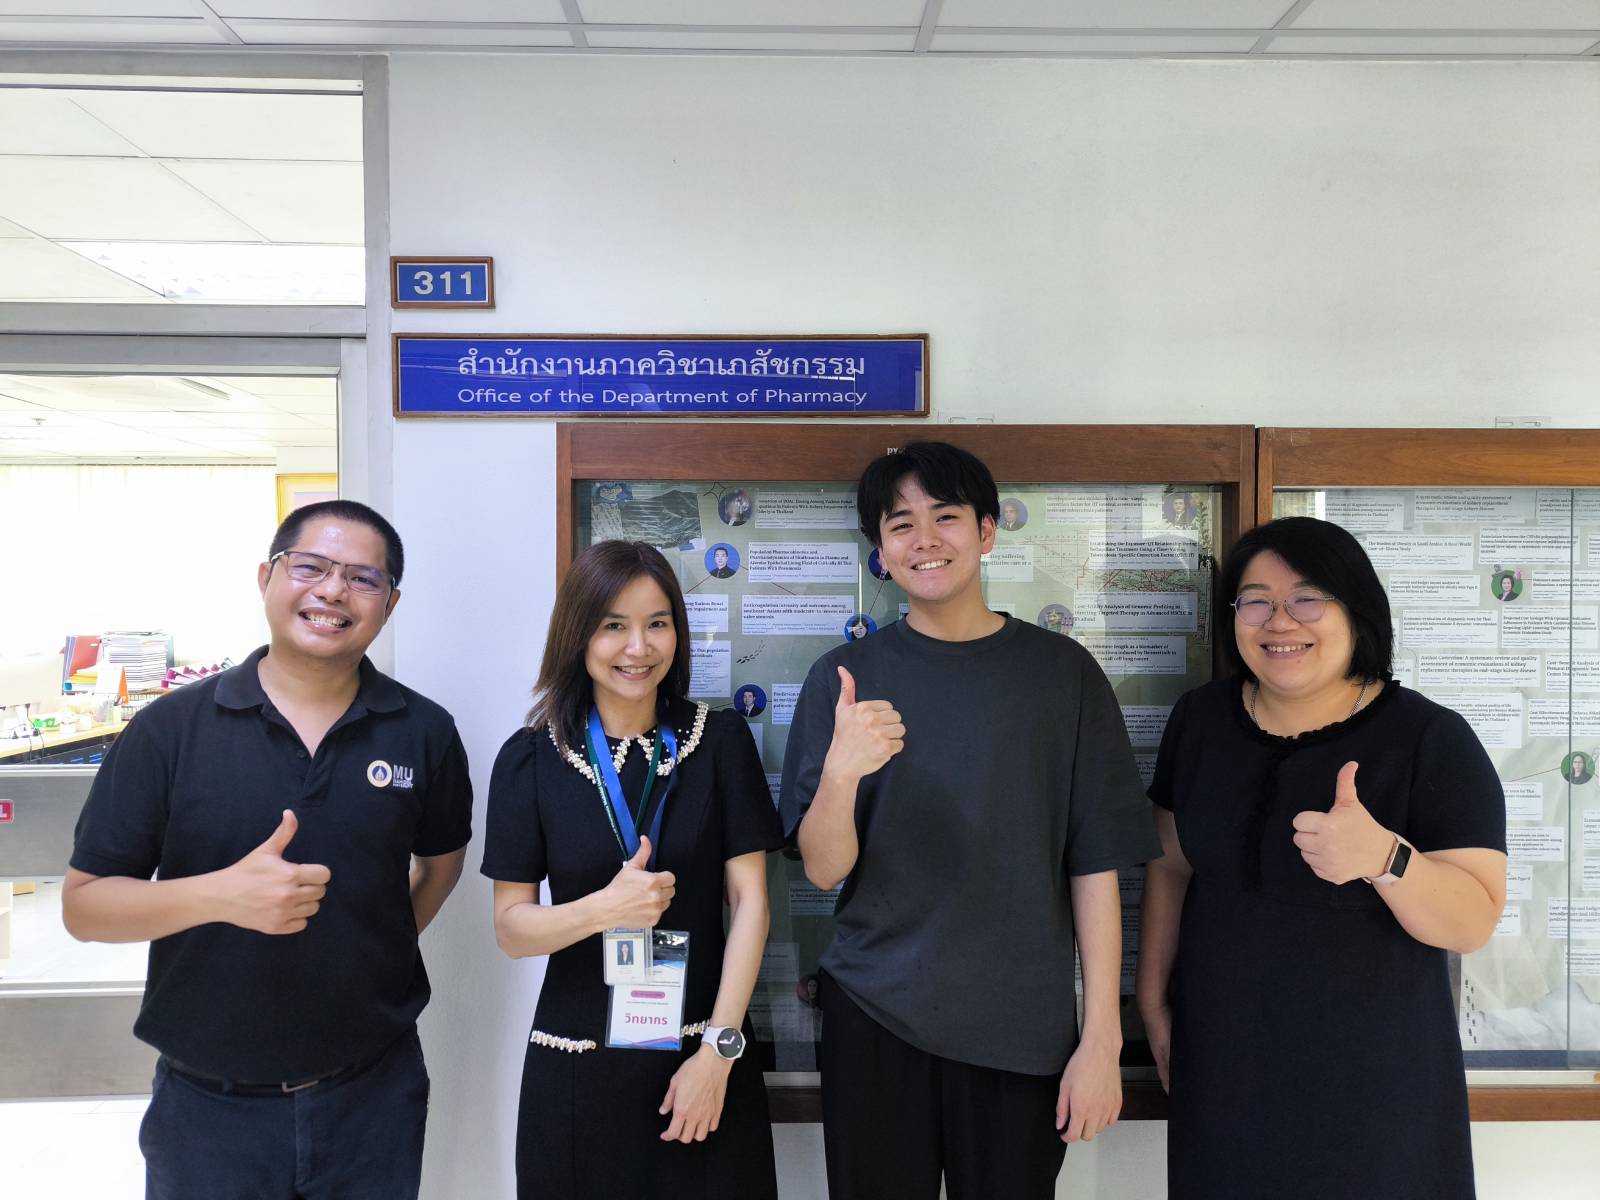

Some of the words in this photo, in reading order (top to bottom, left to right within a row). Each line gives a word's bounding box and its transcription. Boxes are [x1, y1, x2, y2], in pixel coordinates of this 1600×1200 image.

[413, 270, 472, 295] 311
[457, 347, 865, 376] สำนักงานภาควิชาเภสัชกรรม
[458, 388, 522, 403] Office
[529, 388, 553, 403] of
[559, 388, 594, 403] the
[602, 388, 729, 406] Department
[736, 388, 760, 403] of
[766, 388, 868, 406] Pharmacy
[393, 765, 413, 781] MU
[625, 1012, 668, 1025] วิทยากร
